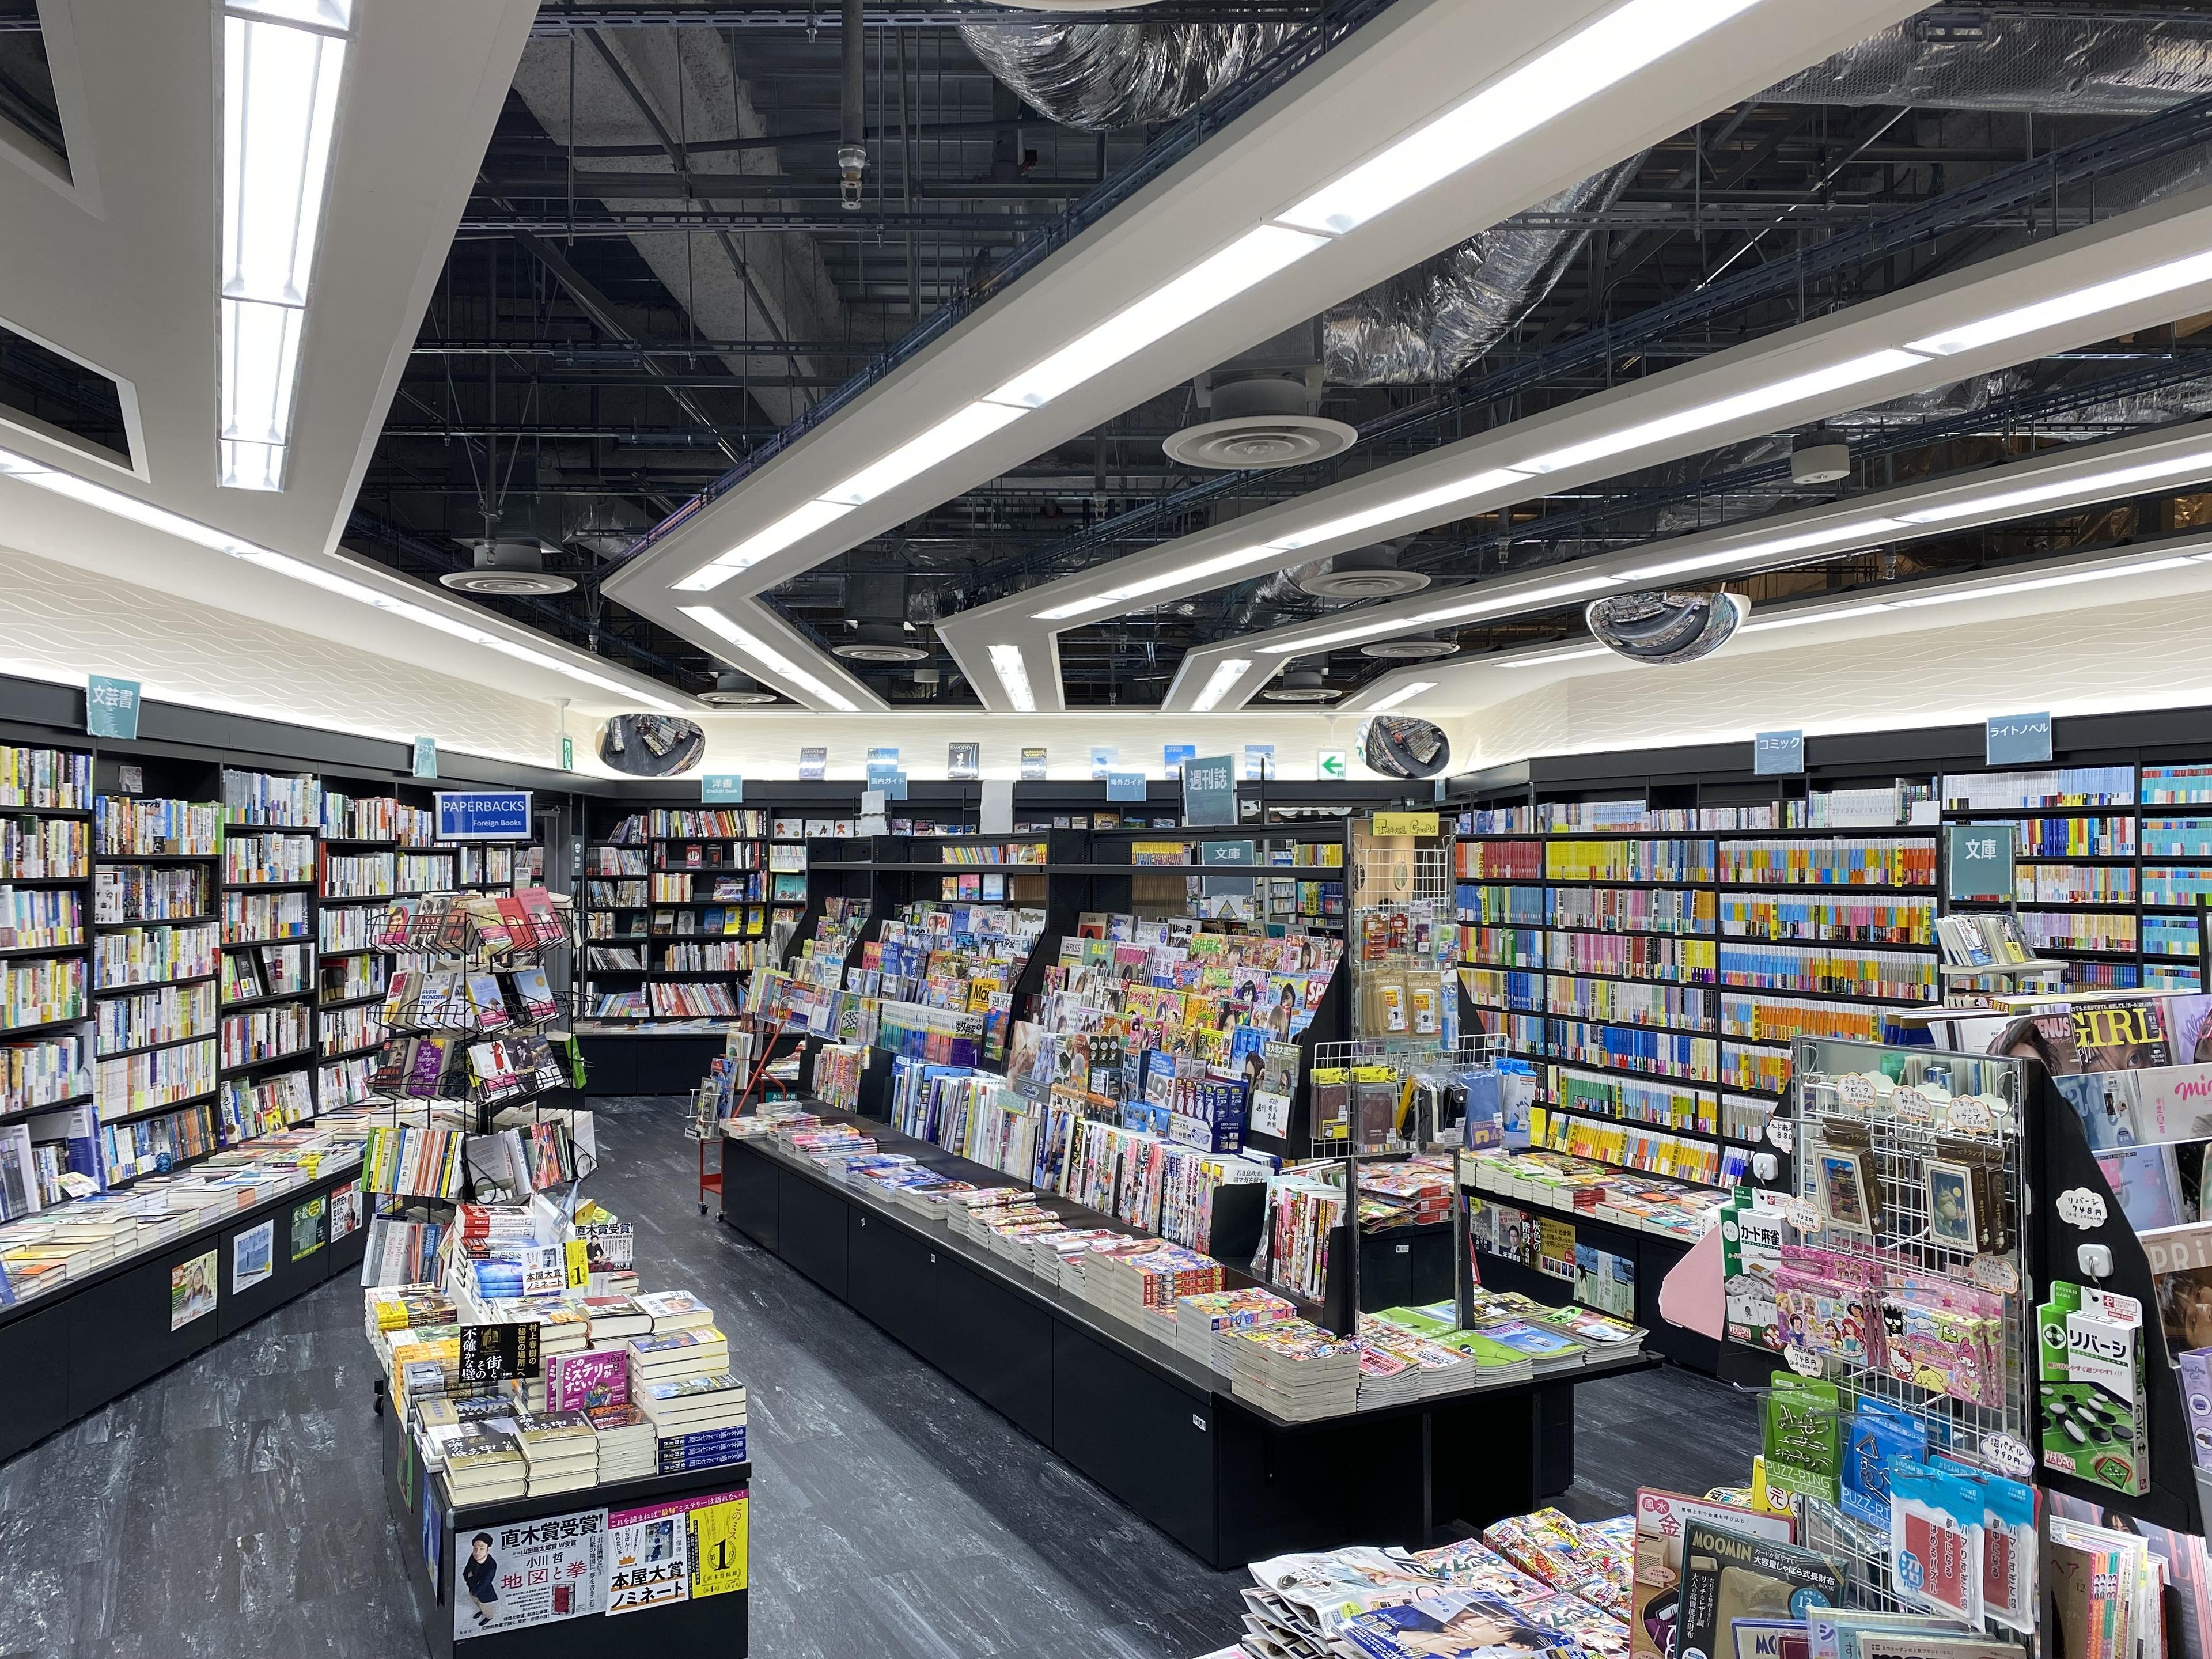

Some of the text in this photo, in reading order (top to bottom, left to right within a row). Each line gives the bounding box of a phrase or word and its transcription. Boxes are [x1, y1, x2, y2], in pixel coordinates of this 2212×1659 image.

[92, 685, 134, 709] 文芸書
[1990, 723, 2048, 737] ライトノベル
[1760, 737, 1800, 750] コミック
[712, 779, 732, 788] 洋書
[1190, 768, 1227, 790] 週刊誌
[442, 801, 525, 813] PAPERBACKS
[473, 820, 499, 828] Foreign
[1215, 848, 1241, 859] 文庫
[1965, 838, 1996, 860] 文庫
[972, 910, 990, 918] GENIC
[1003, 938, 1016, 949] iPad
[1191, 940, 1221, 955] 近代麻雀
[2072, 1007, 2164, 1048] GIRL
[972, 1048, 978, 1065] 1
[1128, 1053, 1138, 1067] BELT
[1124, 1068, 1138, 1084] POUCH
[1844, 1086, 1869, 1094] ラピュタ
[1956, 1112, 1980, 1120] トランプ
[2067, 1196, 2100, 1205] リバーシ
[2073, 1205, 2101, 1215] 748円
[576, 1222, 634, 1236] 直木賞受賞!
[1522, 1221, 1531, 1245] 階段
[1533, 1219, 1541, 1252] 灰色の
[1741, 1224, 1780, 1245] カード麻雀
[385, 1236, 395, 1266] Sapiens
[394, 1237, 404, 1267] Sapiens
[526, 1268, 562, 1281] 本屋大賞
[527, 1279, 563, 1291] ノミネート
[2055, 1285, 2078, 1294] REVERSI
[1729, 1328, 1751, 1339] JAPAN
[517, 1324, 526, 1377] 「秘密の場所」へ
[529, 1324, 537, 1365] 村上春樹の
[2070, 1329, 2127, 1358] リバーシ
[462, 1328, 478, 1381] 不確かな壁
[606, 1355, 624, 1363] 2023
[1793, 1354, 1817, 1366] 748円
[476, 1361, 486, 1378] その
[486, 1355, 502, 1378] 街と
[565, 1363, 615, 1381] ミステリーが
[571, 1359, 584, 1369] この
[565, 1377, 597, 1395] すごい!
[2135, 1404, 2144, 1440] リバーシ
[1990, 1438, 2024, 1456] 沼パズル
[1995, 1449, 2020, 1465] 990円
[2046, 1456, 2074, 1469] JAPAN
[1766, 1461, 1830, 1488] PUZZ-RING
[1643, 1498, 1667, 1512] 風水
[1843, 1487, 1890, 1517] PUZZ-RI
[729, 1502, 743, 1540] このミス
[1658, 1513, 1682, 1538] 金
[501, 1513, 603, 1550] 直木賞受賞!
[521, 1539, 577, 1555] 山田風太郎賞 W受賞
[1692, 1531, 1752, 1562] MOOMIN
[526, 1552, 563, 1569] 小川 哲
[1755, 1549, 1798, 1565] カードが見やすい
[1929, 1523, 1938, 1594] はめるパズル
[501, 1560, 587, 1589] 地図と拳
[612, 1561, 684, 1589] 本屋大賞
[1753, 1556, 1835, 1585] 大容量じゃばら式長財布
[1900, 1552, 1921, 1586] 沼
[1960, 1524, 1969, 1609] ハマりすぎて沼
[2008, 1524, 2017, 1609] ハマりすぎて沼
[611, 1581, 683, 1609] ノミネート
[1819, 1583, 1834, 1592] BOOK
[2077, 1584, 2085, 1593] 12
[1686, 1573, 1699, 1639] 大人の高機能長財布
[1696, 1575, 1708, 1628] リッチなレザー調
[1798, 1596, 1811, 1609] 13
[1819, 1624, 1835, 1641] シ
